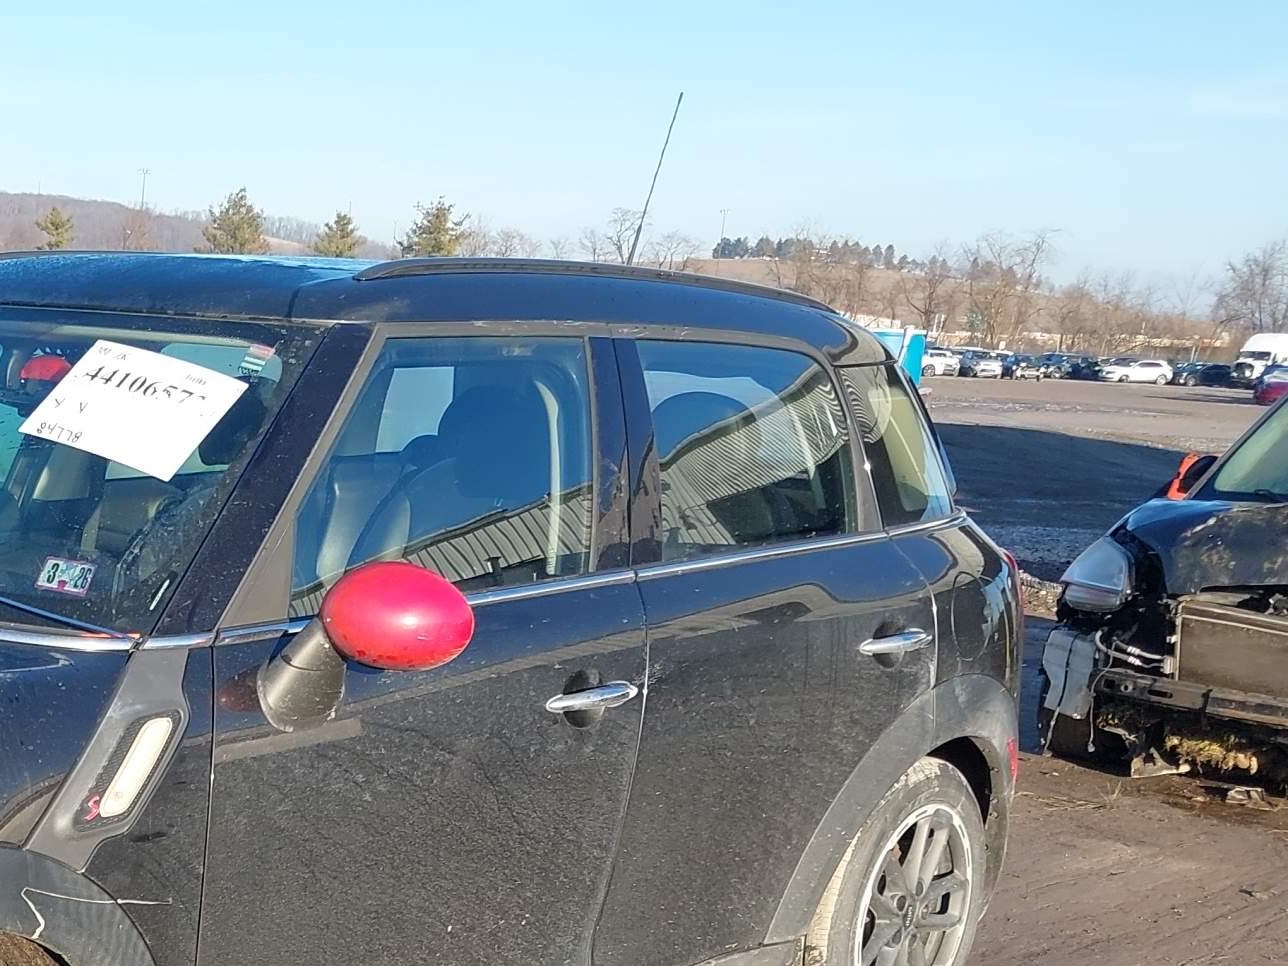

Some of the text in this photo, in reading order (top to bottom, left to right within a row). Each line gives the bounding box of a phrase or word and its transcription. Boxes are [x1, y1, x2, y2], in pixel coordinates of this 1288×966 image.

[83, 365, 209, 406] 4410657
[46, 562, 92, 590] 3 26
